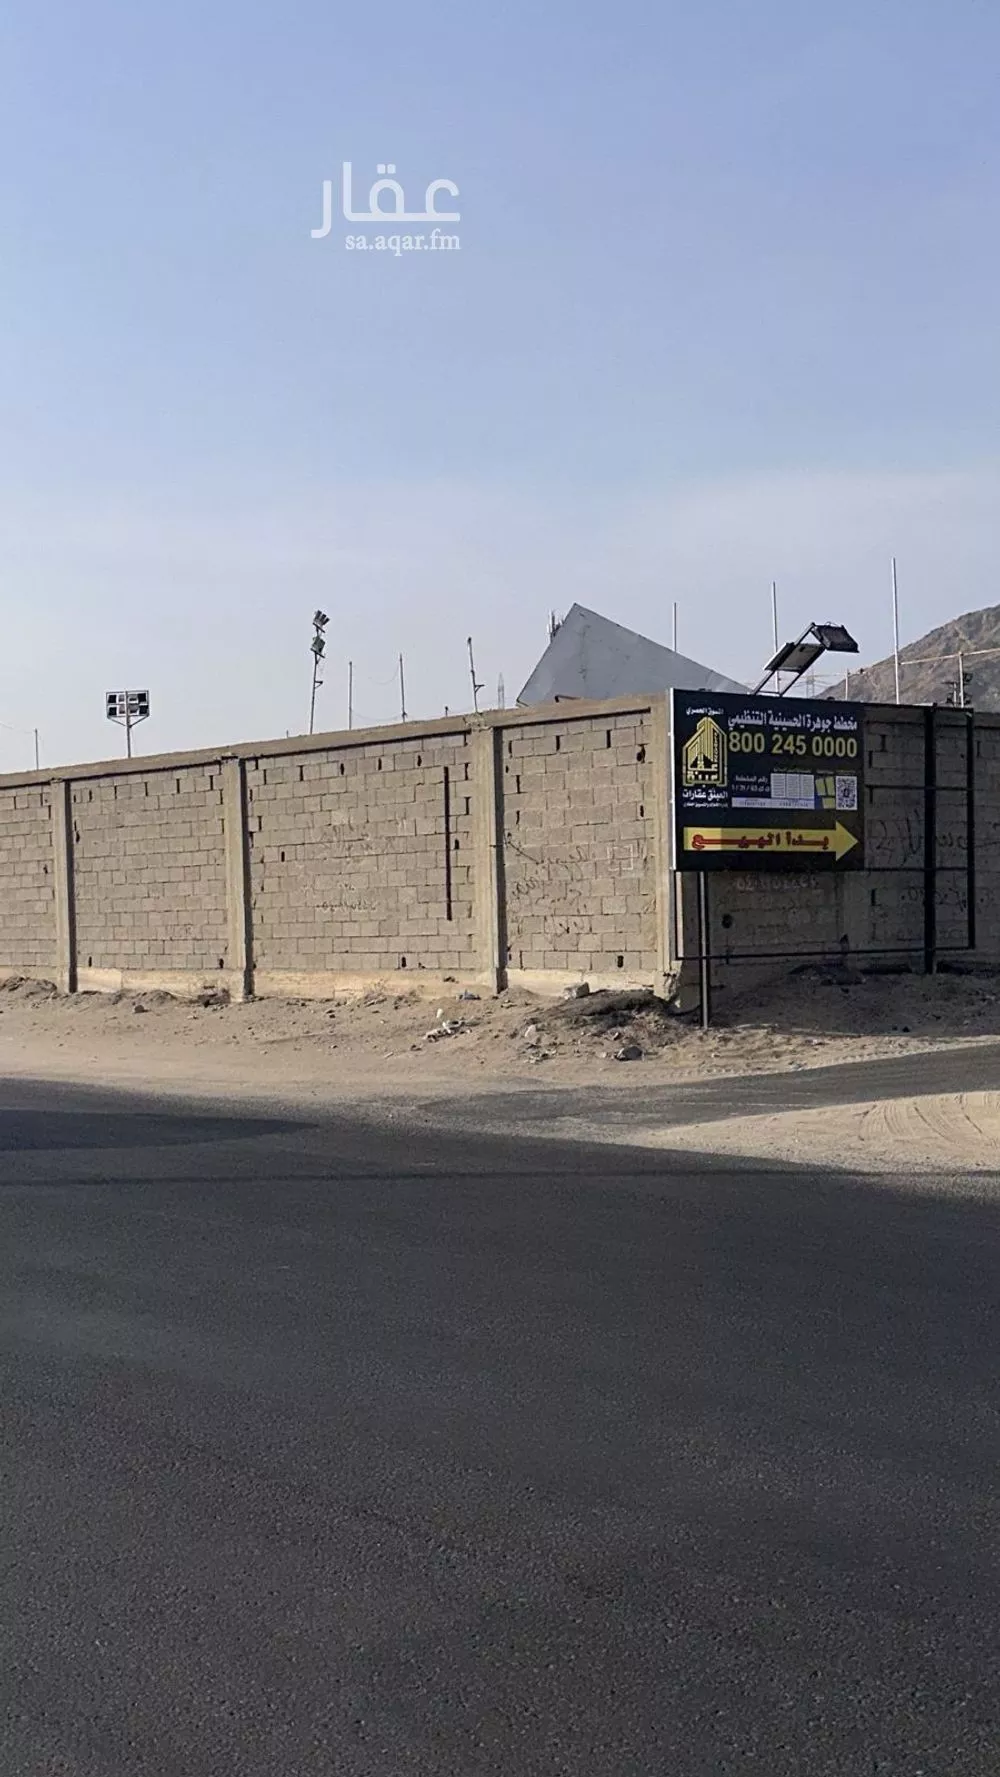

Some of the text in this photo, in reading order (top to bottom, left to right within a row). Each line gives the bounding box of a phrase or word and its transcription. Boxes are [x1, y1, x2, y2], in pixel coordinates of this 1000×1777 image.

[727, 709, 858, 733] مخطط جوهرة الحسينية التنظيمي
[728, 732, 766, 753] 800
[771, 734, 807, 756] 245
[812, 736, 858, 758] 0000
[682, 788, 707, 801] عقارات
[691, 832, 781, 850] البيع
